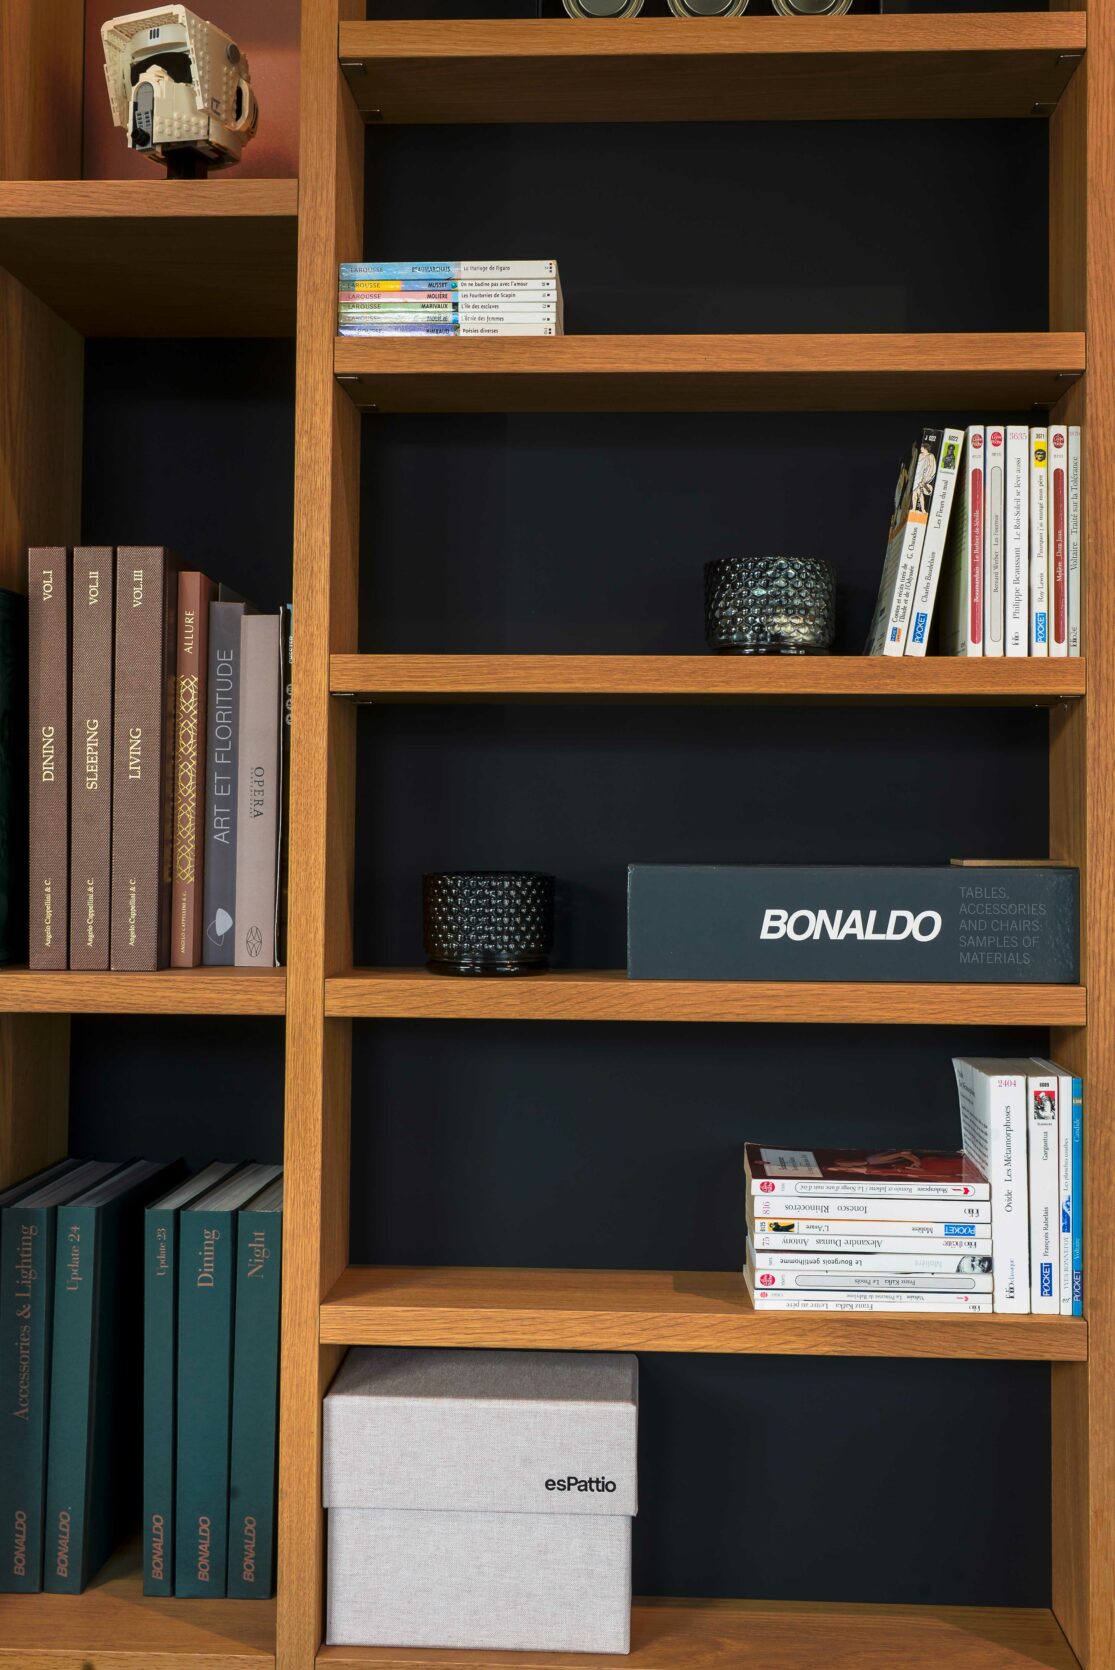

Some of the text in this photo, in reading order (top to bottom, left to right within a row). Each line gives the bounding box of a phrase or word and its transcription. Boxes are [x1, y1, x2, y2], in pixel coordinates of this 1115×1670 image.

[1013, 476, 1021, 488] lève
[1070, 457, 1080, 491] Tolérance
[934, 480, 949, 529] Les Fleurs du mal
[1012, 498, 1021, 530] Roi-Soleil
[1014, 532, 1021, 540] Le
[1070, 514, 1078, 535] Traité
[1012, 547, 1021, 585] Beaussant
[1070, 542, 1078, 570] Voltaire
[42, 569, 53, 600] VOL.I
[89, 571, 99, 605] VOL.II
[133, 569, 143, 607] VOL.III
[921, 551, 937, 602] Charles Baudelaire
[1012, 587, 1025, 619] Philippe
[1038, 591, 1046, 602] Roy
[892, 605, 902, 623] Contes
[914, 613, 926, 643] POCKET
[1037, 612, 1045, 642] POCKET
[183, 610, 195, 654] ALLURE
[41, 725, 54, 782] DINING
[86, 718, 99, 791] SLEEPING
[129, 727, 142, 780] LIVING
[213, 649, 234, 844] ART ET FLORITUDE
[253, 766, 264, 819] OPERA
[45, 878, 51, 886] C.
[87, 878, 94, 886] C.
[129, 877, 136, 885] C.
[959, 886, 1010, 900] TABLES,
[44, 894, 52, 924] Cappellini
[86, 894, 95, 924] Cappellini
[959, 903, 1047, 916] ACCESSORIES
[44, 925, 52, 947] Angelo
[86, 925, 95, 947] Angelo
[128, 924, 137, 946] Angelo
[760, 909, 942, 942] BONALDO
[959, 919, 988, 932] AND
[959, 935, 1040, 948] SAMPLES OF
[959, 952, 1031, 965] MATERIALS
[998, 1079, 1016, 1087] 2404
[1003, 1105, 1013, 1167] Métamorphoses
[785, 1204, 868, 1214] Ionesco Rhinocéros
[1005, 1189, 1013, 1212] Ovide
[782, 1236, 883, 1247] Alexandre Dumas Antony
[944, 1226, 975, 1234] POCKET
[66, 1225, 83, 1291] Update 24
[156, 1228, 167, 1276] Update 23
[197, 1229, 220, 1288] Dining
[248, 1230, 271, 1278] Night
[780, 1257, 820, 1266] gentilhomme
[822, 1258, 853, 1266] Bourgeois
[786, 1299, 800, 1308] père
[13, 1225, 38, 1420] Accessories & Lighting
[545, 1476, 616, 1492] esPattio
[14, 1510, 26, 1576] BONALDO
[56, 1511, 70, 1577] BONALDO
[152, 1514, 163, 1580] BONALDO
[198, 1516, 210, 1581] BONALDO
[243, 1516, 256, 1582] BONALDO
